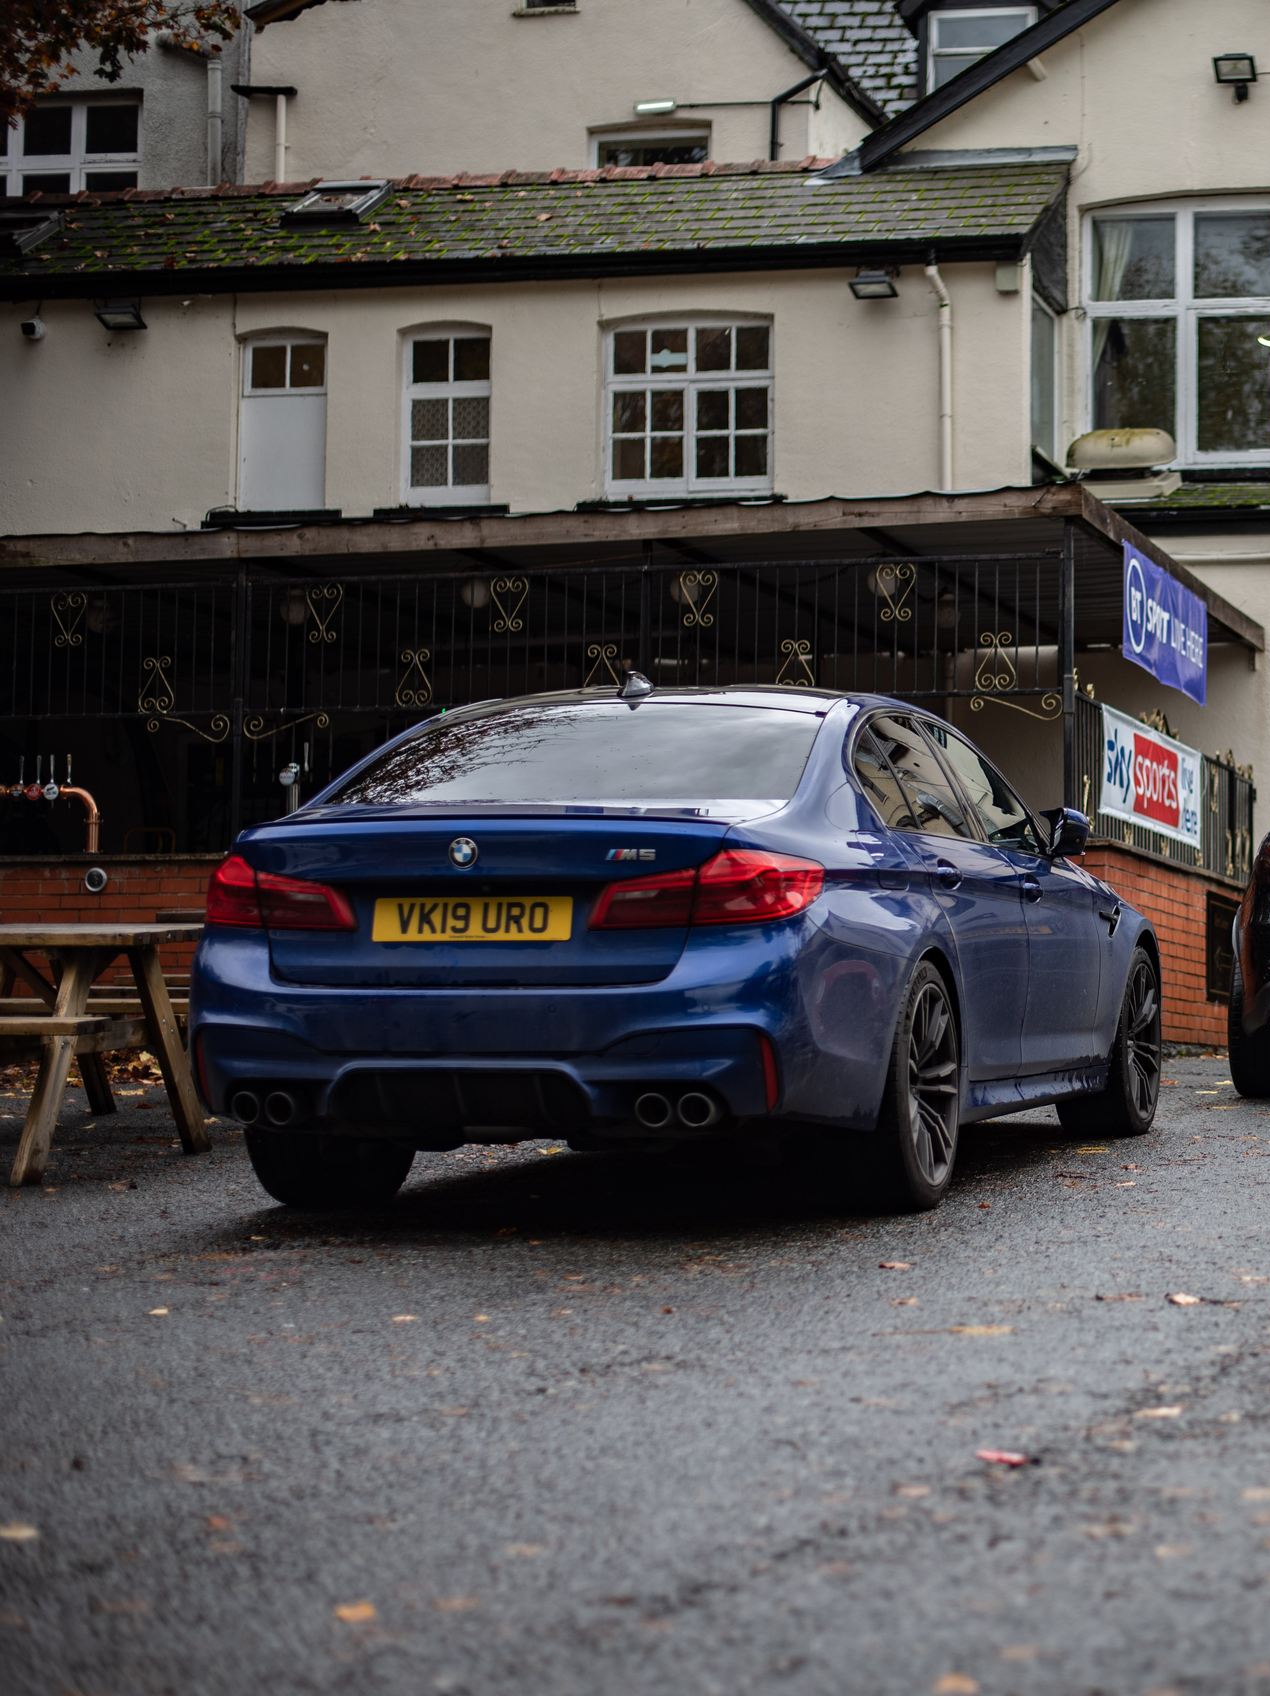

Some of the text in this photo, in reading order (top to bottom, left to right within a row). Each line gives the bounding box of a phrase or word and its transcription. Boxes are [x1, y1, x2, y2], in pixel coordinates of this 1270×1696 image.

[1131, 586, 1142, 624] BT
[1107, 728, 1178, 809] sky sports
[618, 849, 656, 861] M5
[397, 901, 550, 934] VK19 URO
